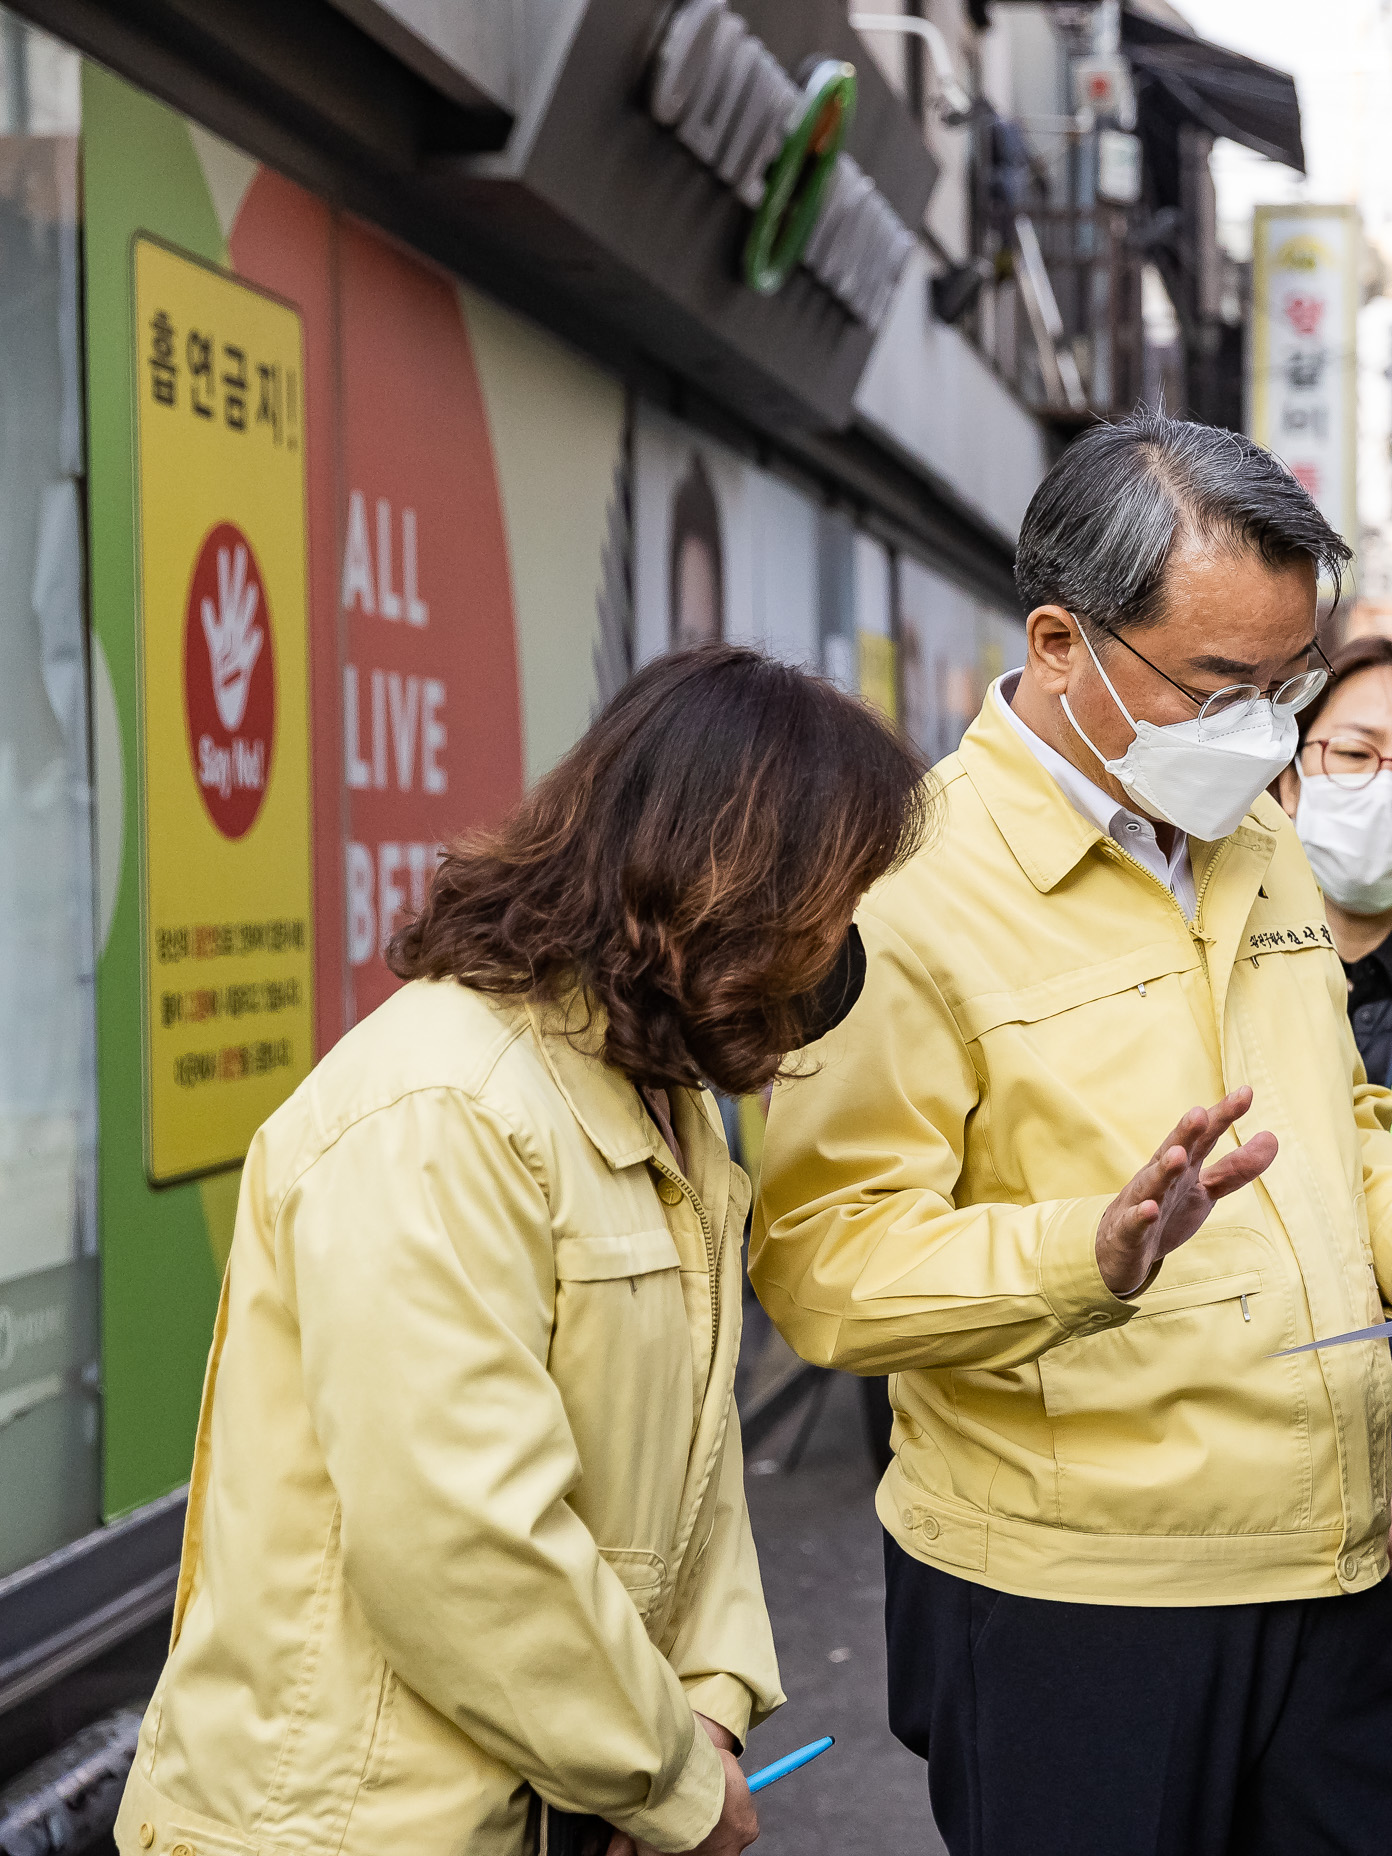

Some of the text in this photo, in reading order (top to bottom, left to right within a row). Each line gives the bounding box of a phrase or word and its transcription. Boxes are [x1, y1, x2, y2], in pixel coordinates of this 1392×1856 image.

[149, 310, 299, 449] 흡연금지!
[343, 490, 428, 628] ALL
[199, 733, 232, 799] Say
[343, 663, 449, 794] LIVE
